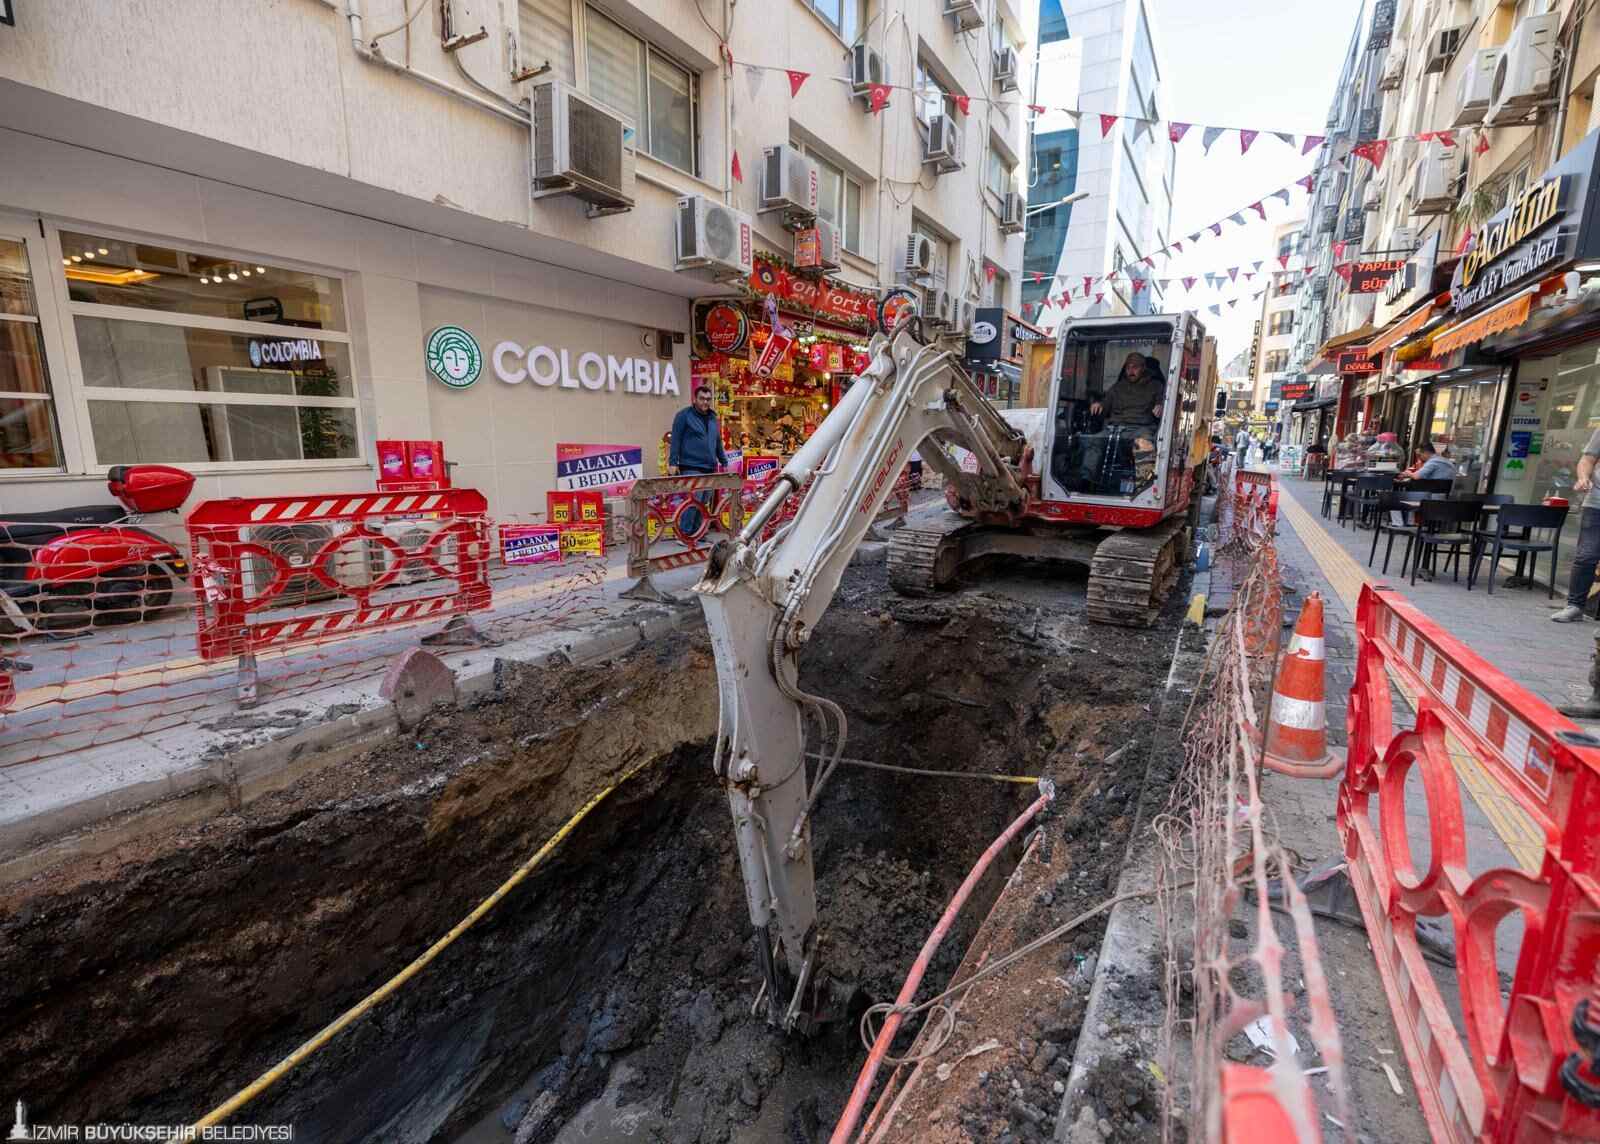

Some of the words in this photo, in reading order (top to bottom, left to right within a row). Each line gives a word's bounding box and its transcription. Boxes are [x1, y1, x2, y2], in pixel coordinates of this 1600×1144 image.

[1499, 225, 1561, 288] Yemekleri
[260, 339, 322, 363] COLOMBIA
[492, 340, 680, 396] COLOMBIA
[576, 453, 629, 472] ALANA
[578, 468, 638, 488] BEDAVA
[555, 510, 568, 519] 50
